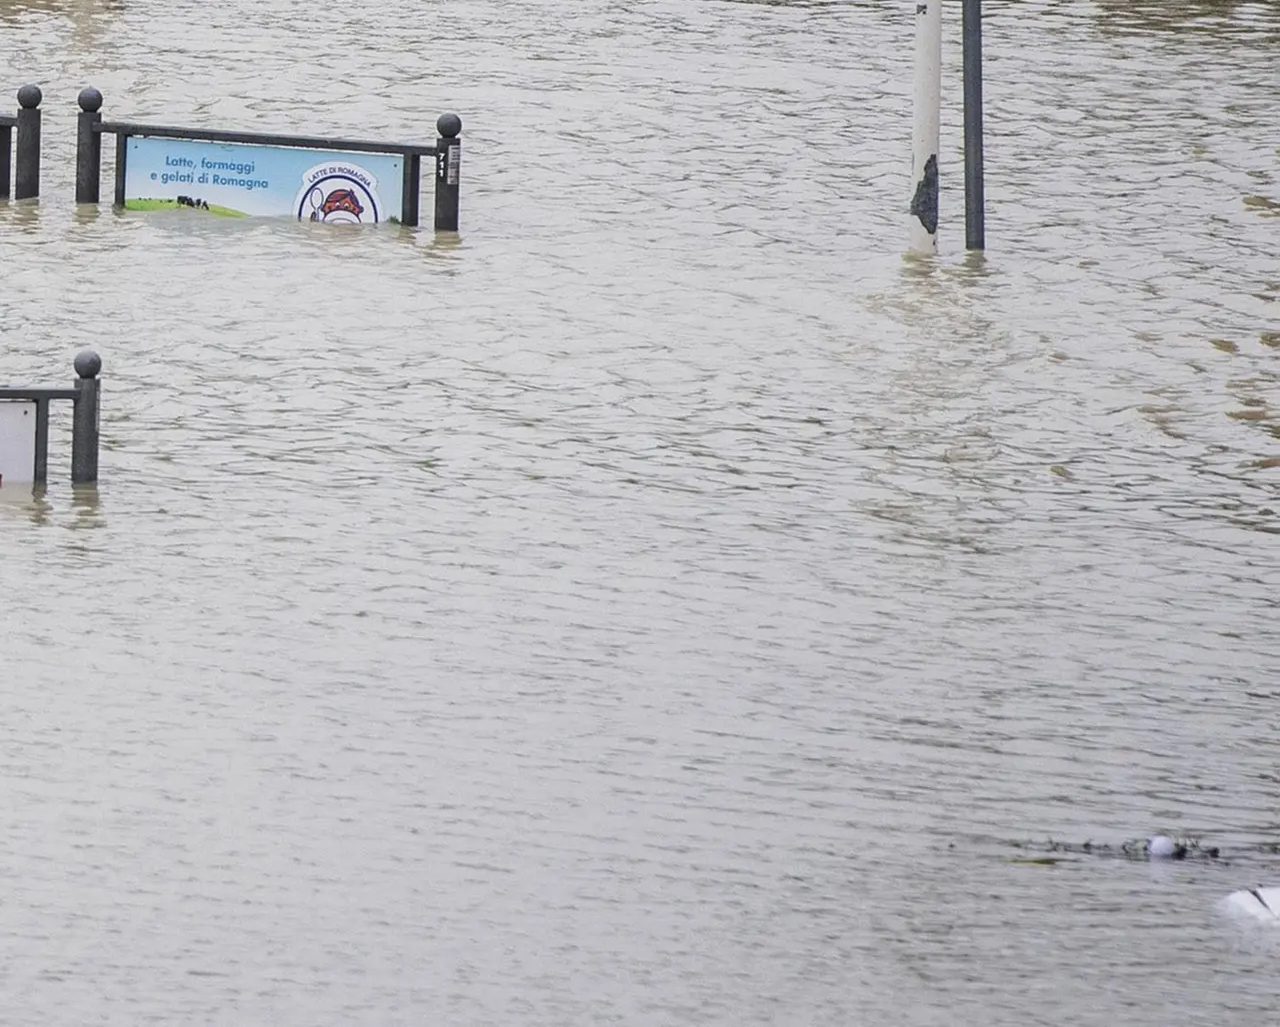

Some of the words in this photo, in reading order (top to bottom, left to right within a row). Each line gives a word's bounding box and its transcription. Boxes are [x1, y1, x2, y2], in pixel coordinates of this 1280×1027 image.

[166, 156, 197, 170] Latte,
[201, 158, 255, 174] formaggi
[150, 172, 157, 180] e
[161, 171, 194, 184] gelati
[198, 173, 209, 184] di
[213, 174, 269, 190] Romagna
[308, 169, 327, 183] LATTE
[338, 167, 371, 187] ROMAGNA
